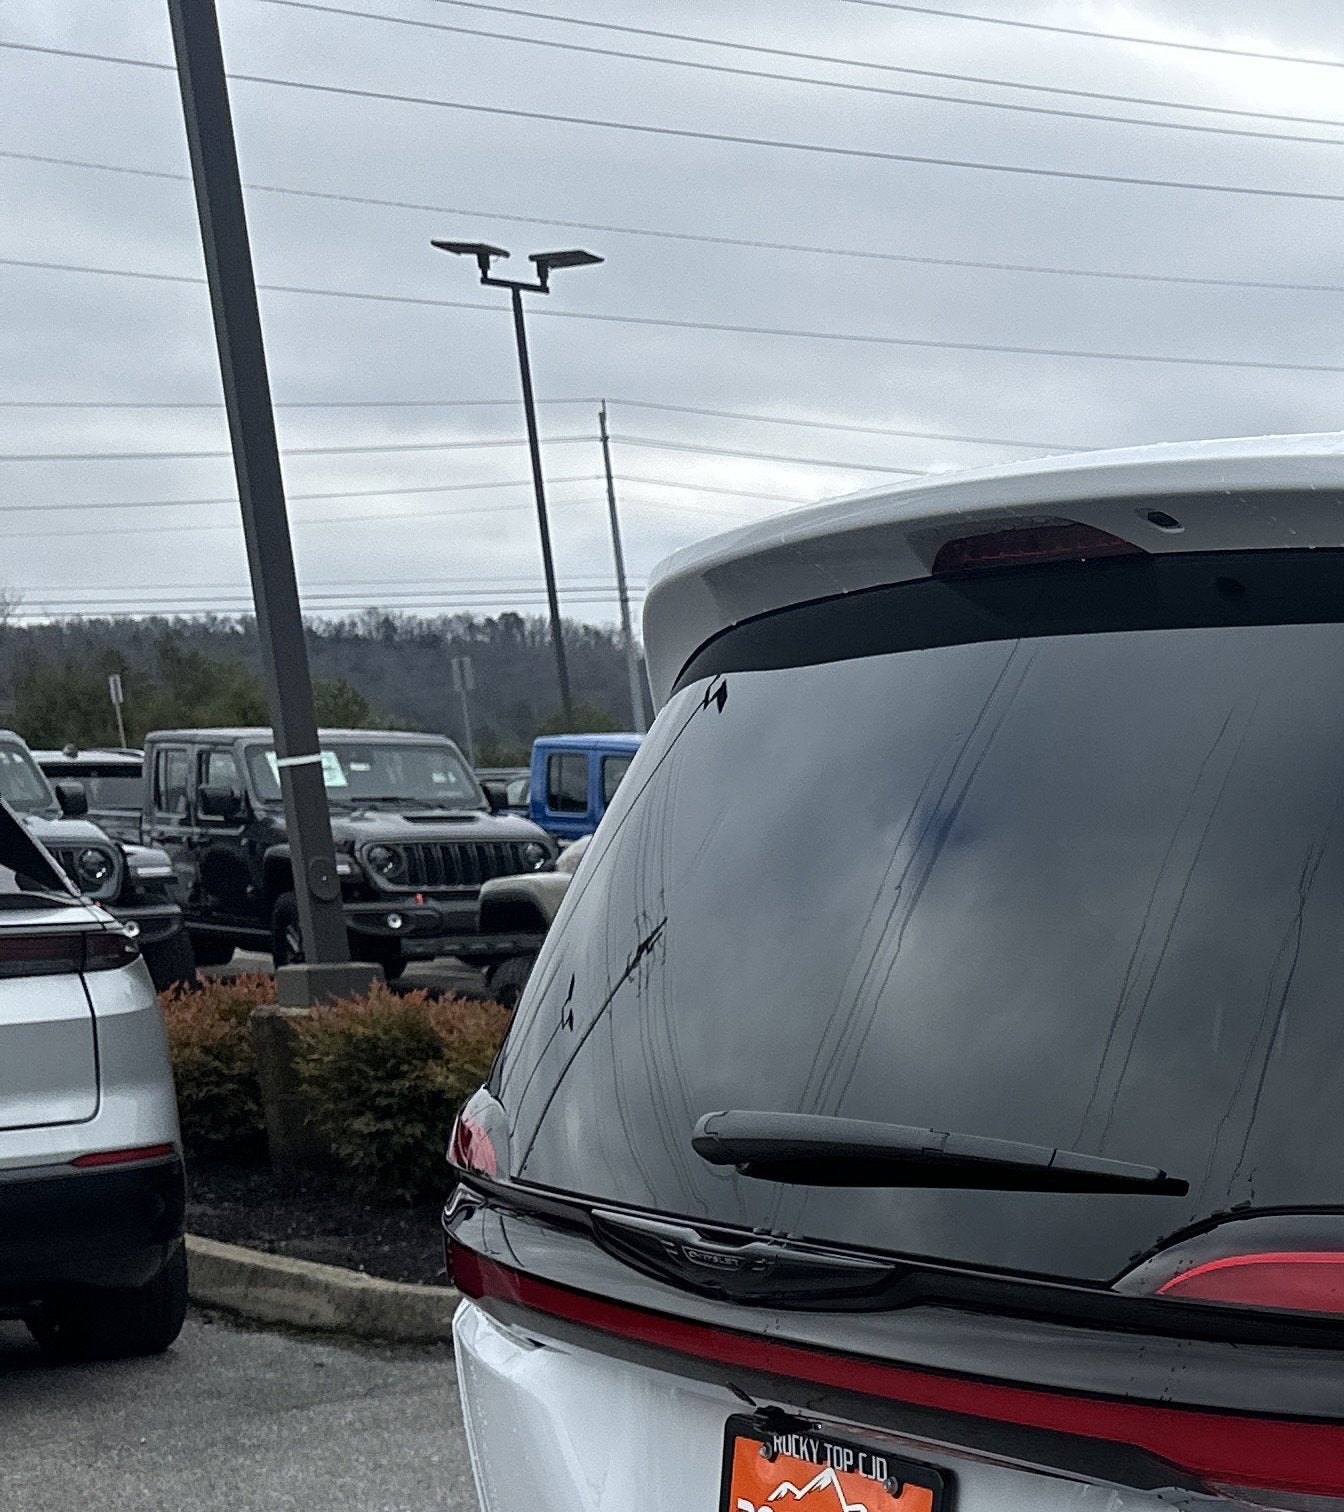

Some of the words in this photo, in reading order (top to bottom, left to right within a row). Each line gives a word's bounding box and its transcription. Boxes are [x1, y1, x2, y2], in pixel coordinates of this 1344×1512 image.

[773, 1433, 819, 1464] ROCKY
[824, 1442, 854, 1472] TOP
[858, 1453, 888, 1482] CJD
